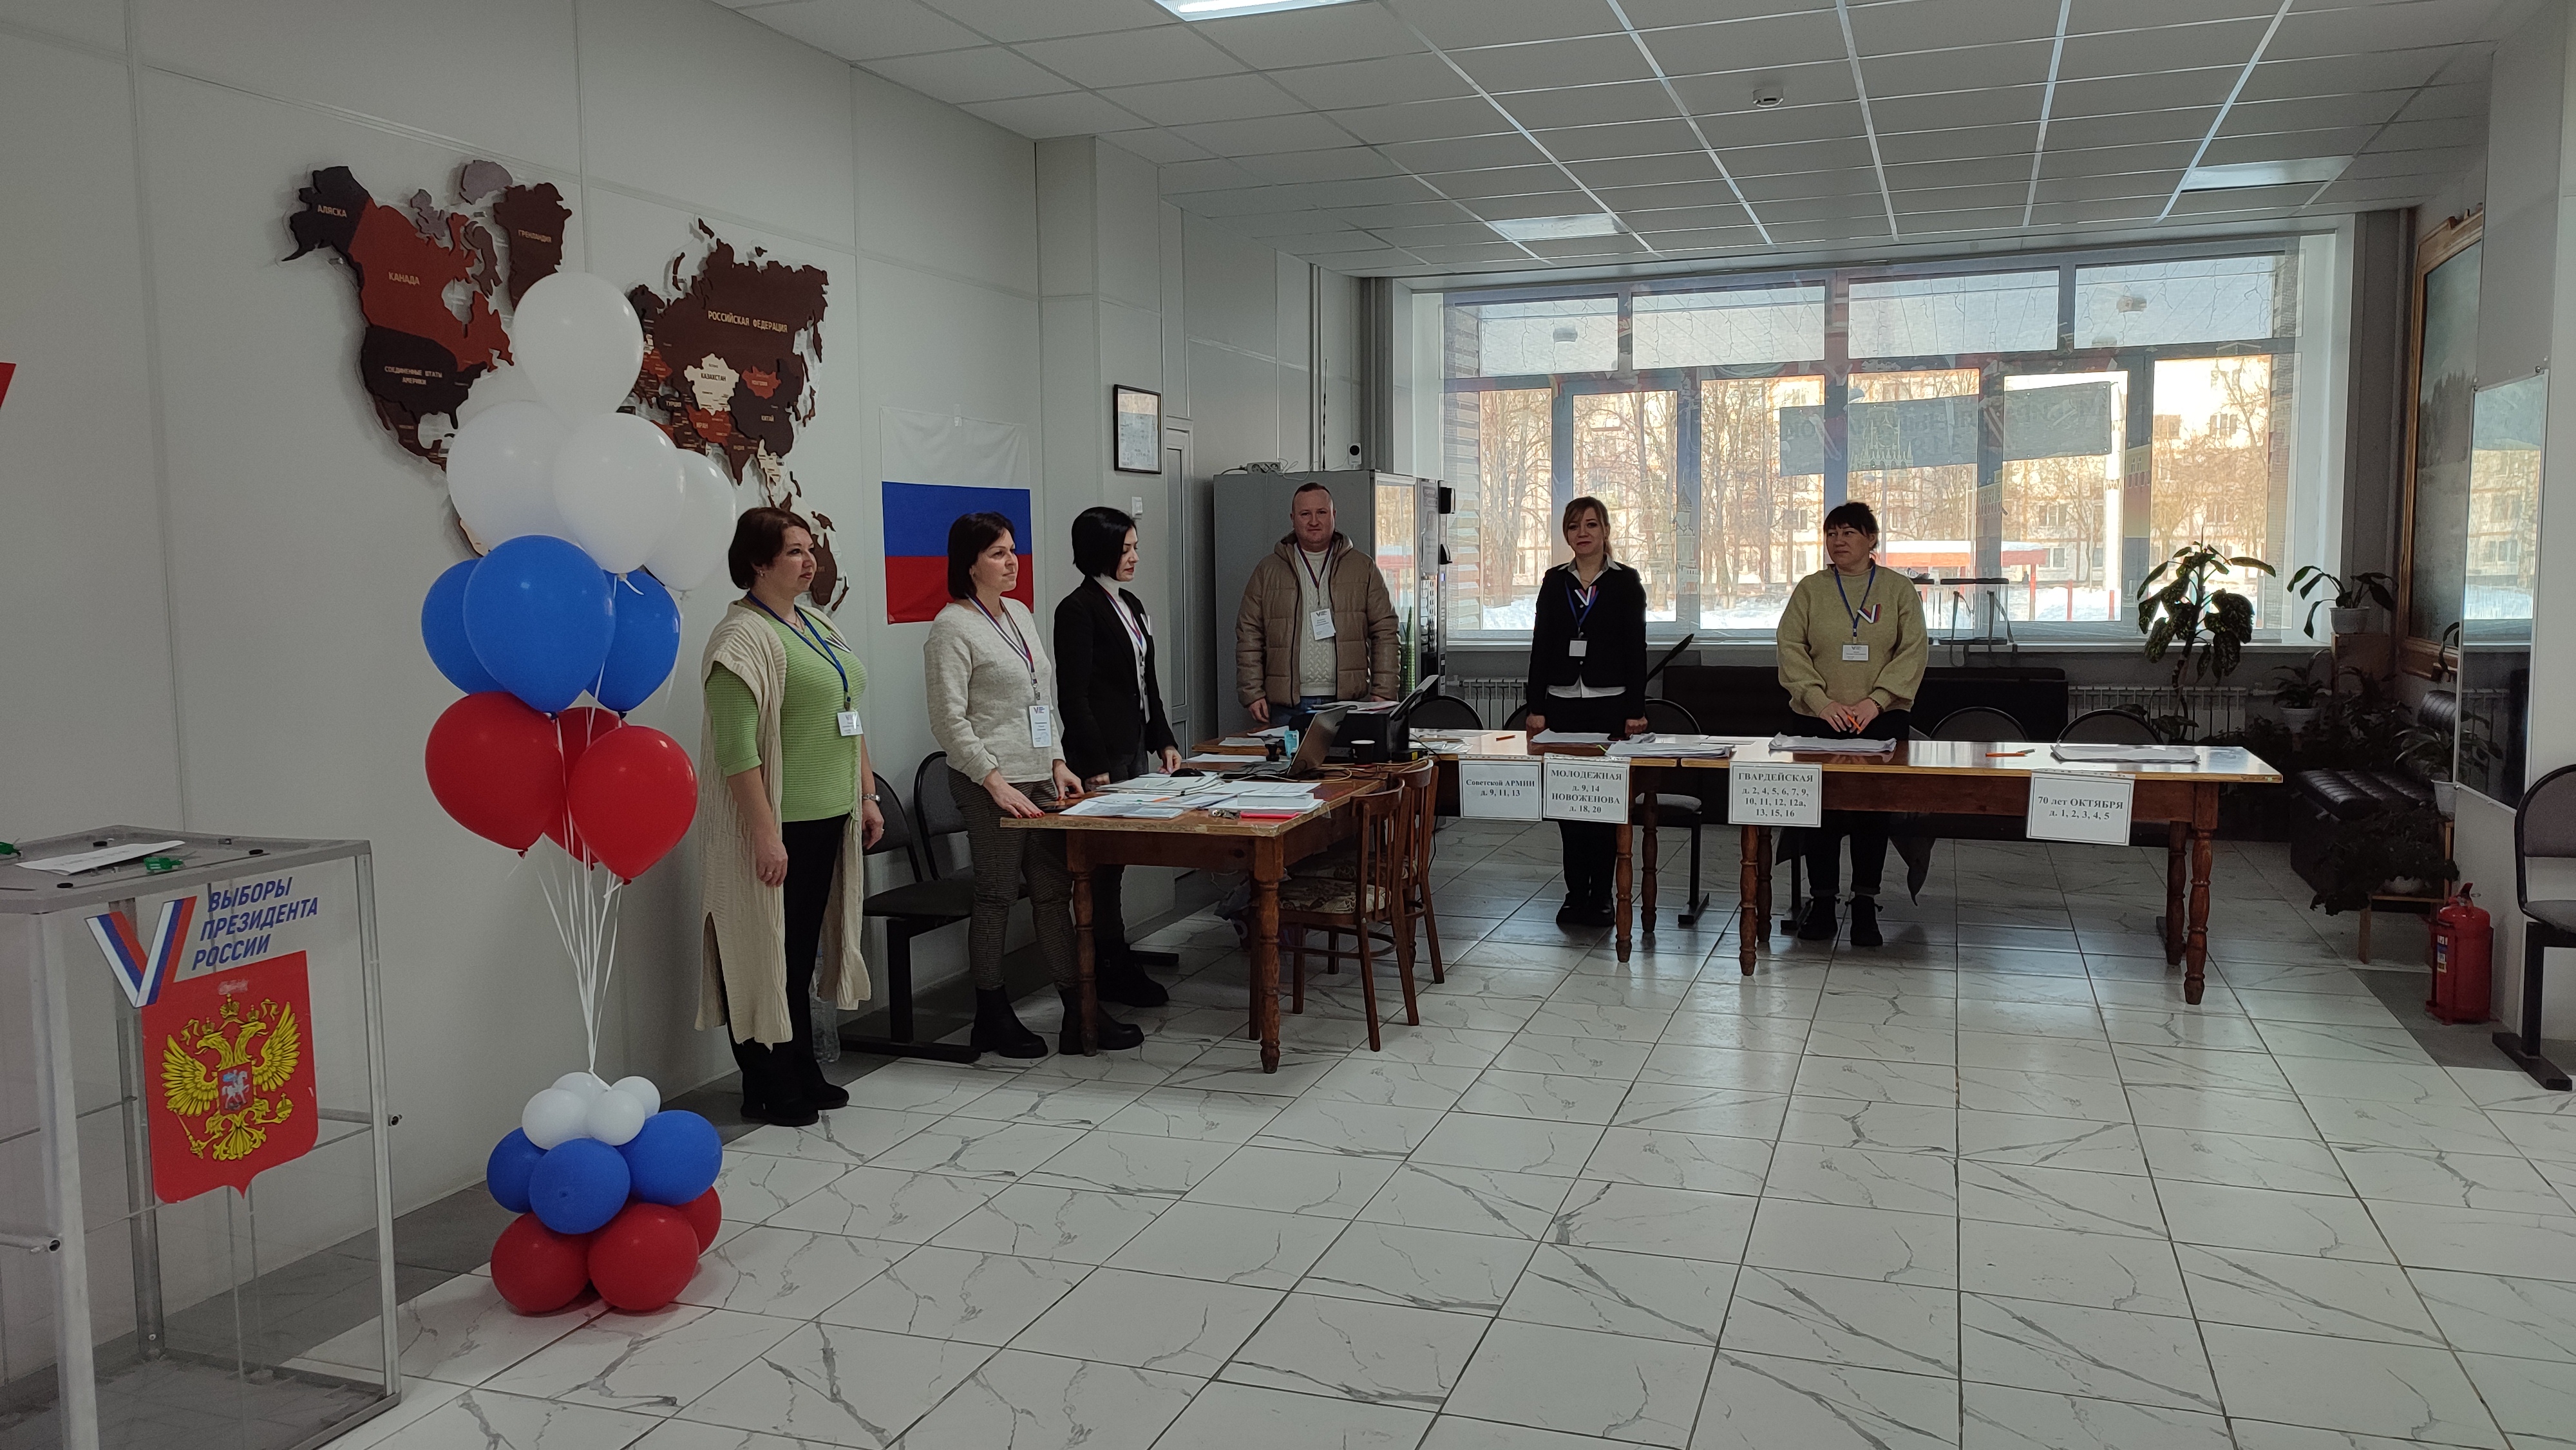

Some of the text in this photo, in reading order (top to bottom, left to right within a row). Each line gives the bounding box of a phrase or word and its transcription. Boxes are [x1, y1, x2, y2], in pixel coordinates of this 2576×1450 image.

[317, 204, 347, 218] АЛЯСКА
[388, 272, 420, 285] КАНАДА
[708, 310, 788, 333] РОССИЙСКАЯ ФЕДЕРАЦИЯ
[701, 373, 726, 382] КАЗАХСТАН
[1551, 769, 1622, 780] МОЛОДЕЖНАЯ
[1738, 772, 1814, 782] ГВАРДЕЙСКАЯ
[1490, 789, 1497, 797] 9,
[1752, 787, 1759, 795] 2,
[1781, 787, 1789, 796] 6,
[1801, 789, 1809, 797] 9,
[1552, 793, 1620, 804] НОВОЖЕНОВА
[1745, 798, 1757, 806] 10,
[1760, 798, 1772, 806] 11,
[1775, 798, 1786, 807] 12,
[2070, 798, 2123, 809] ОКТЯБРЯ
[1579, 805, 1590, 813] 18,
[2061, 809, 2069, 818] 1,
[2071, 810, 2079, 818] 2,
[2081, 811, 2090, 820] 3,
[2093, 811, 2101, 820] 4,
[207, 876, 293, 913] ВЫБОРЫ
[200, 897, 318, 941] ПРЕЗИДЕНТА
[191, 934, 271, 971] РОССИИ
